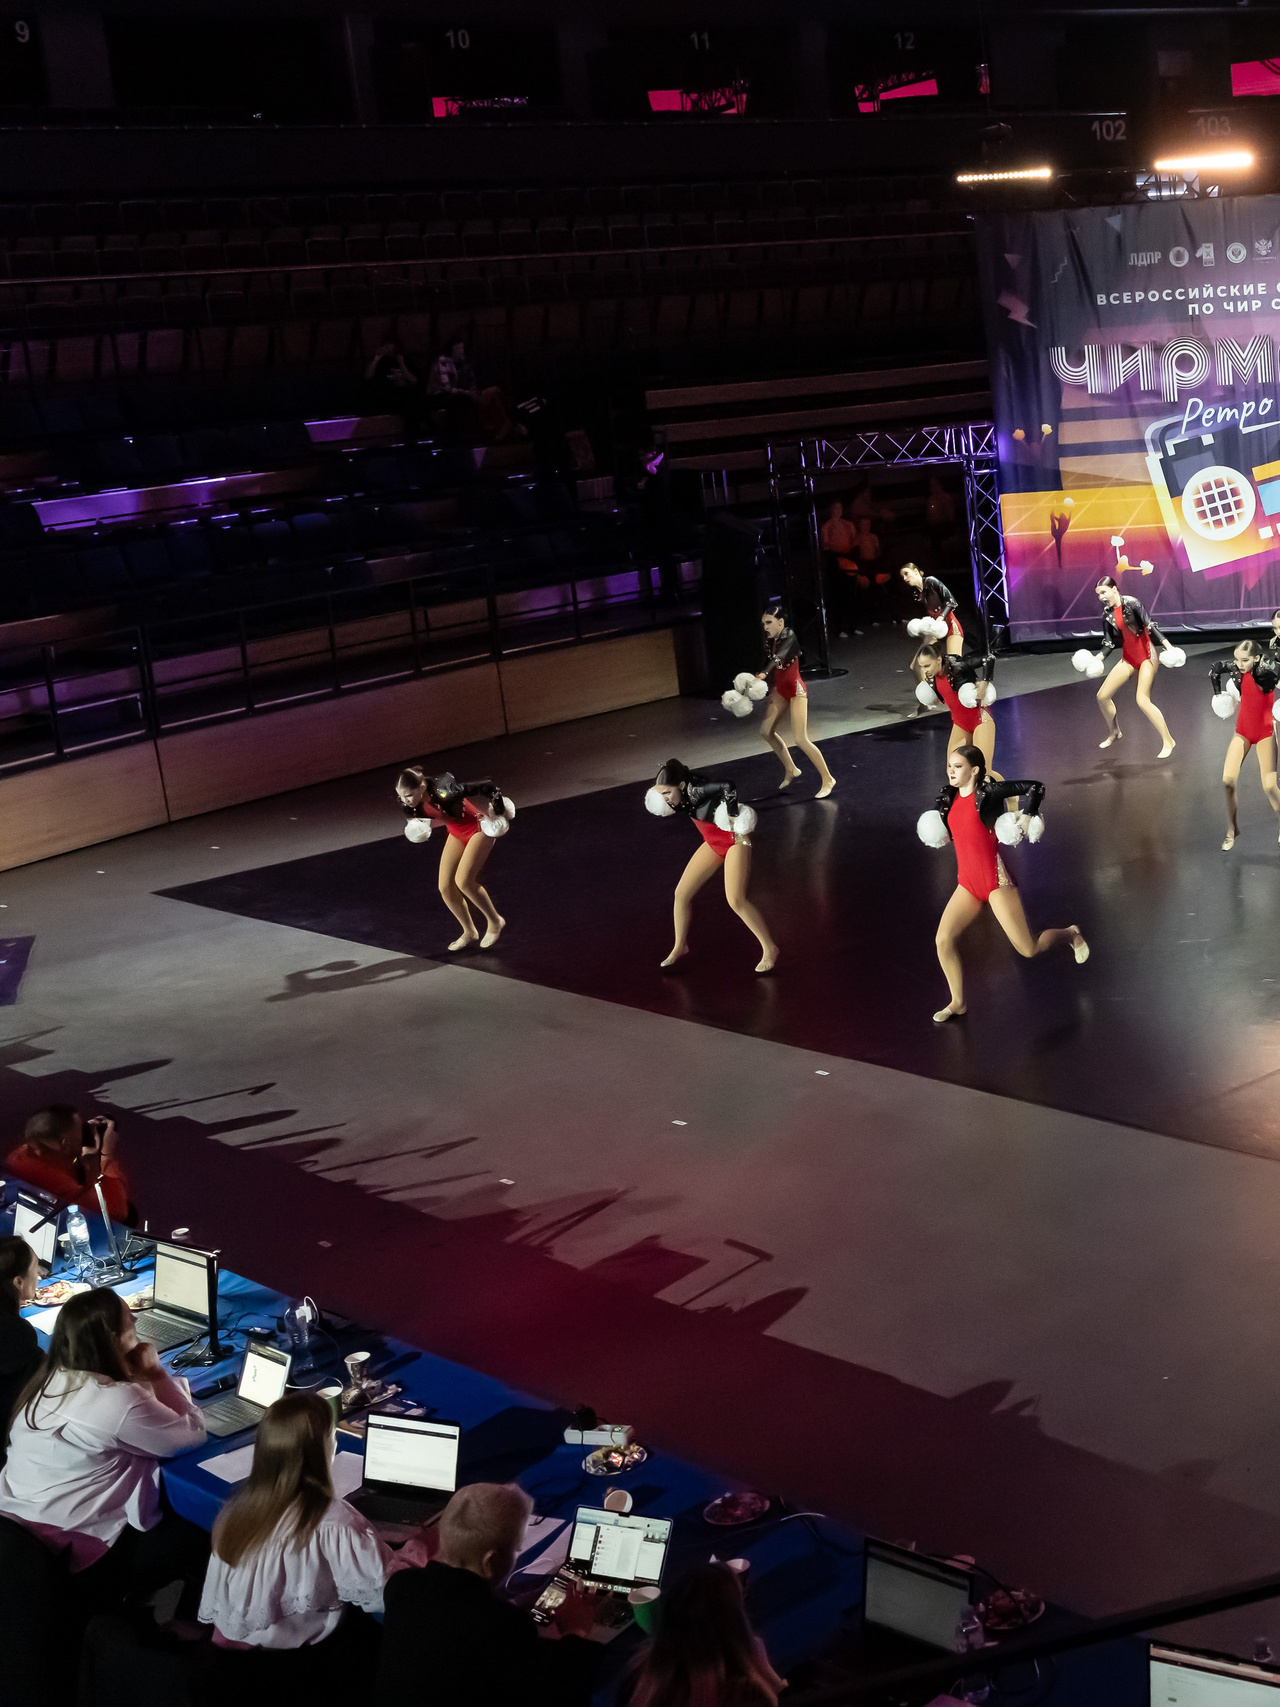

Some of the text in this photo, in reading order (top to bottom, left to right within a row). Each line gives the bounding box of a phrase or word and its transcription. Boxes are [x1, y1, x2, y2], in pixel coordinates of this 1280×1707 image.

[14, 20, 30, 43] 9
[445, 28, 471, 50] 10
[690, 30, 710, 51] 11
[894, 31, 916, 50] 12
[1091, 119, 1127, 142] 102
[1128, 251, 1162, 267] ЛДПР
[1096, 282, 1268, 306] ВСЕРОССИЙСКИЕ
[1188, 302, 1215, 316] ПО
[1223, 299, 1263, 315] ЧИР
[1180, 397, 1275, 435] Ретро
